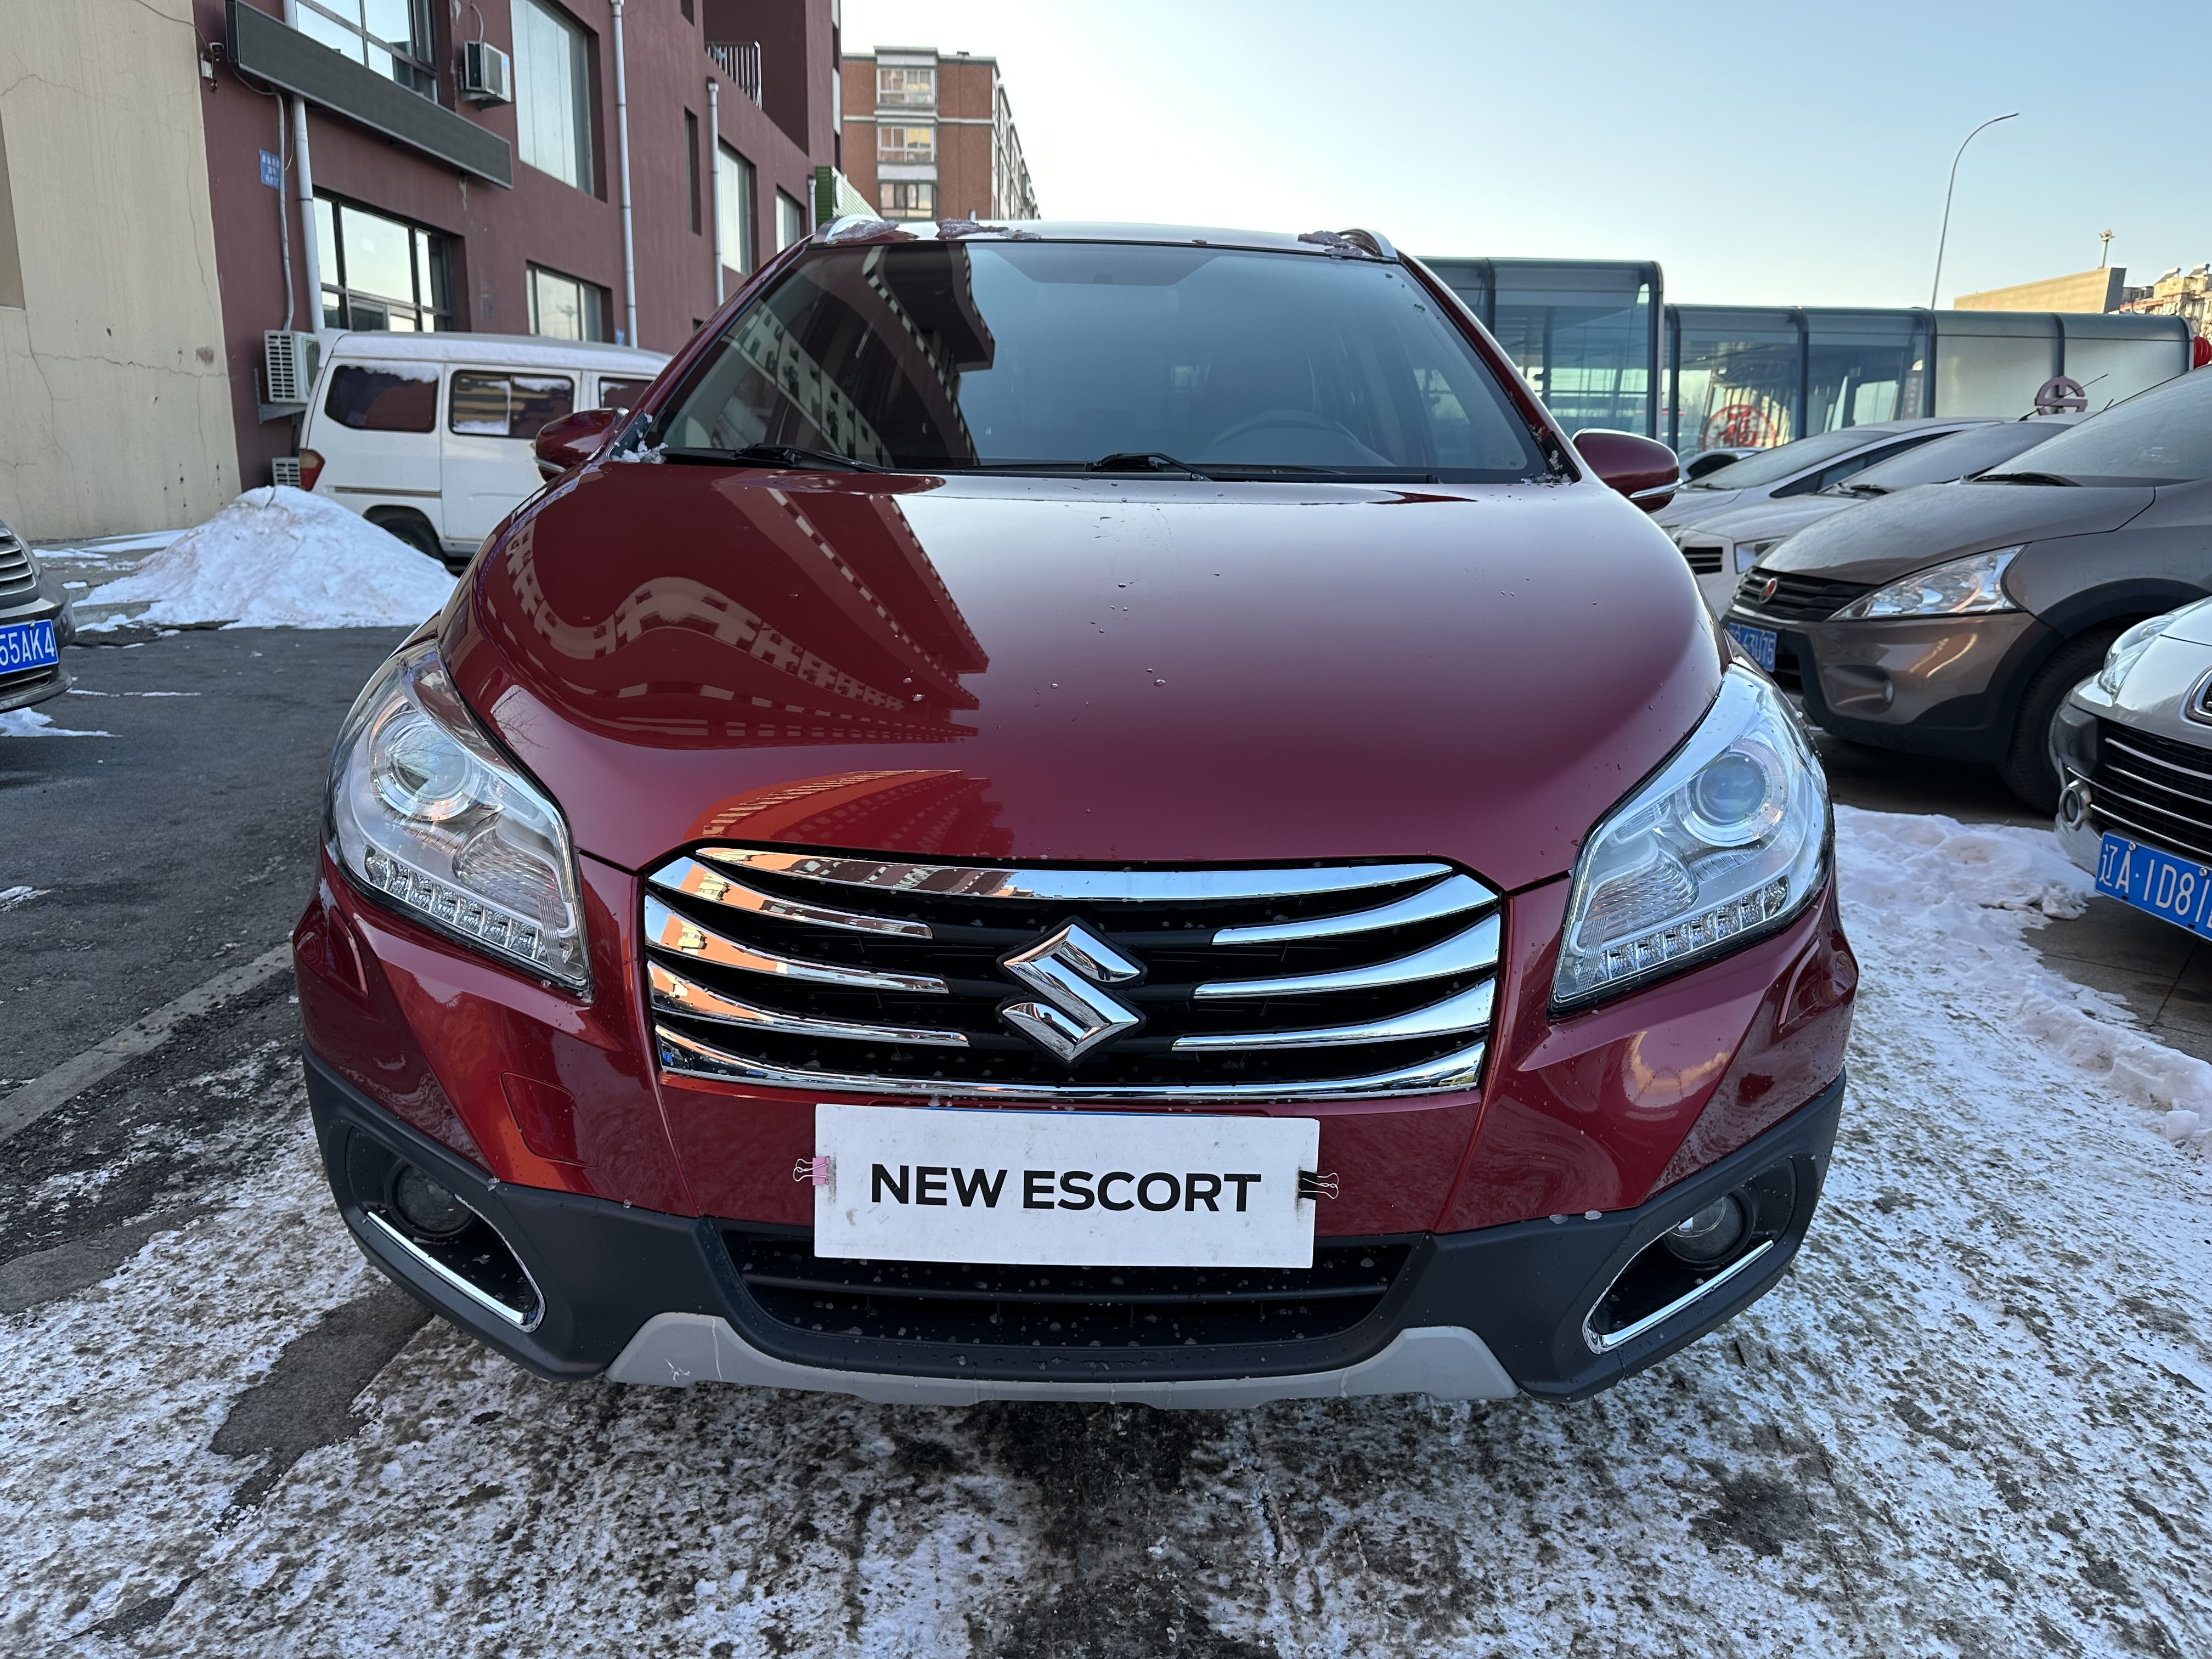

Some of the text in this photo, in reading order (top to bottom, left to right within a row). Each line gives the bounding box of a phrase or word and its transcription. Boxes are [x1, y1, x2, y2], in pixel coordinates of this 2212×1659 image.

[0, 627, 55, 666] 55AK4
[2099, 844, 2212, 929] 辽A·1D81
[872, 1164, 1261, 1211] NEW ESCORT
